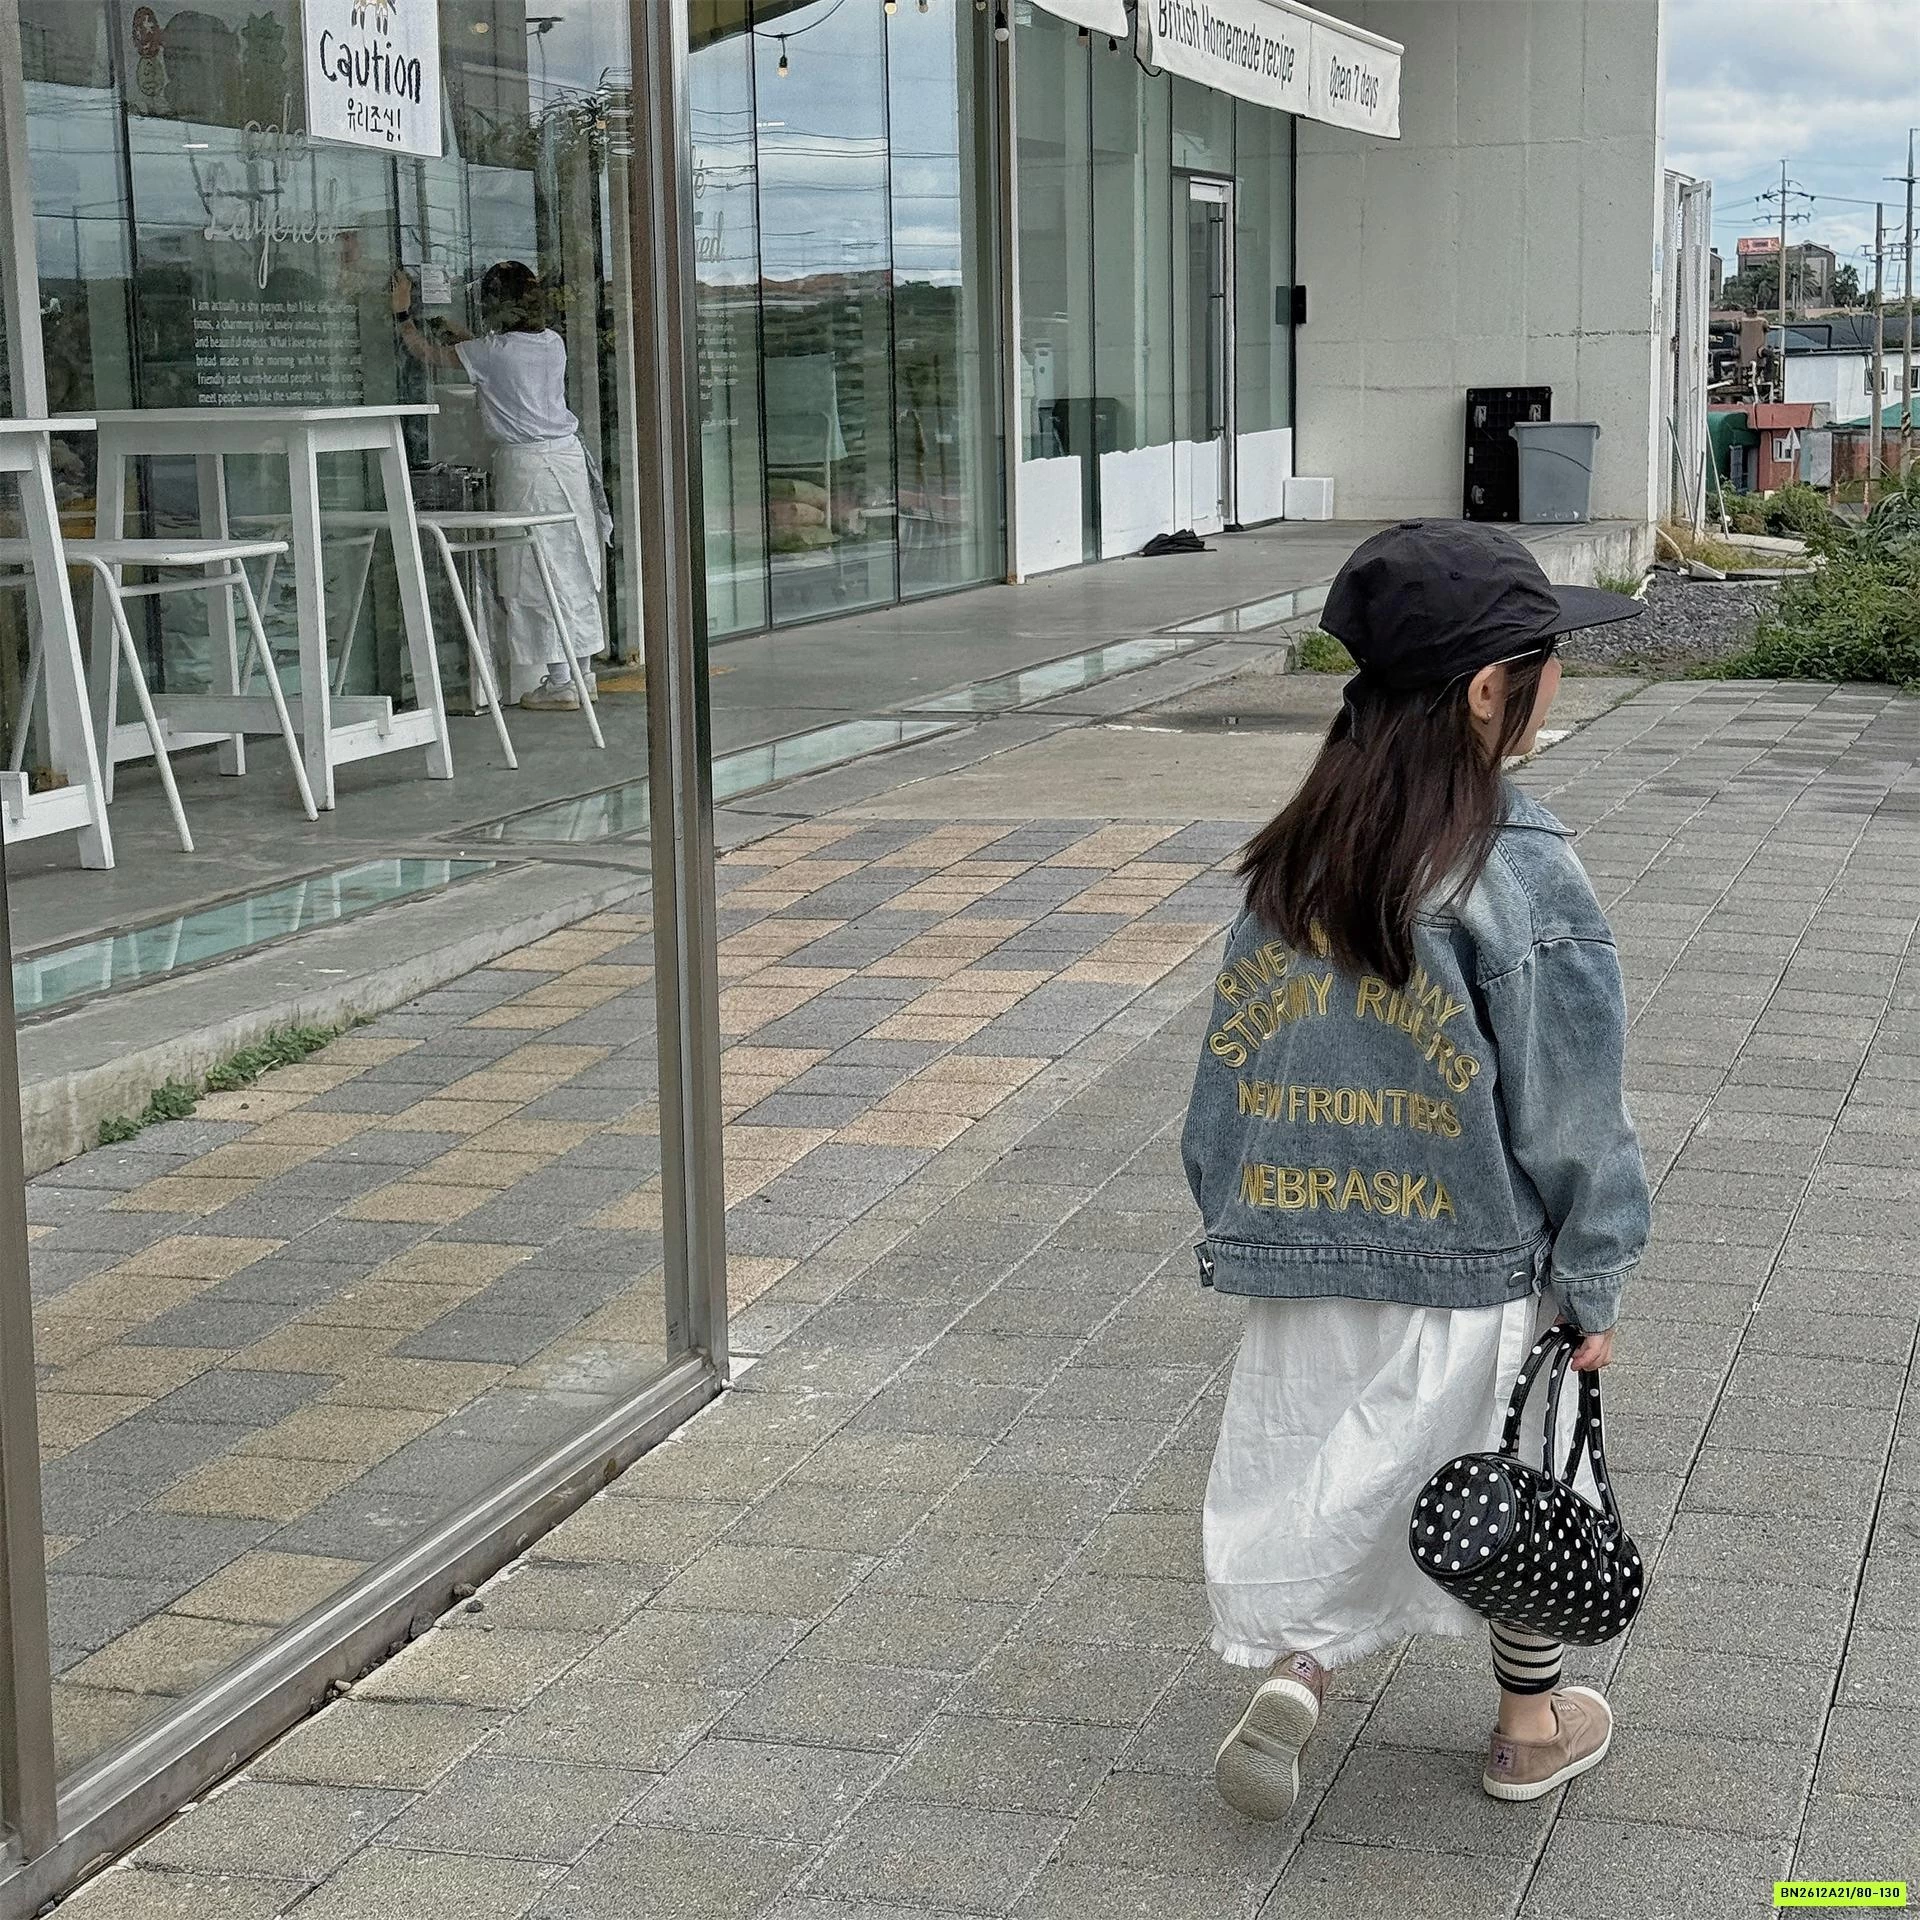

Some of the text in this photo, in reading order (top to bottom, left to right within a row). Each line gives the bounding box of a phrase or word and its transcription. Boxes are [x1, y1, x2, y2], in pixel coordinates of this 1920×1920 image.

[320, 29, 421, 104] Caution
[1159, 0, 1295, 90] British Homemade recipe
[1329, 55, 1379, 116] Open 7 days
[347, 98, 401, 142] 유리조심!
[196, 354, 216, 366] bread
[220, 354, 239, 366] made
[198, 372, 224, 387] friendly
[227, 373, 240, 384] and
[198, 392, 217, 403] meet
[218, 391, 241, 405] people
[1215, 939, 1293, 1008] RIVE
[1238, 1080, 1462, 1138] NEW FRONTIERS
[1238, 1163, 1458, 1225] NEBRASKA
